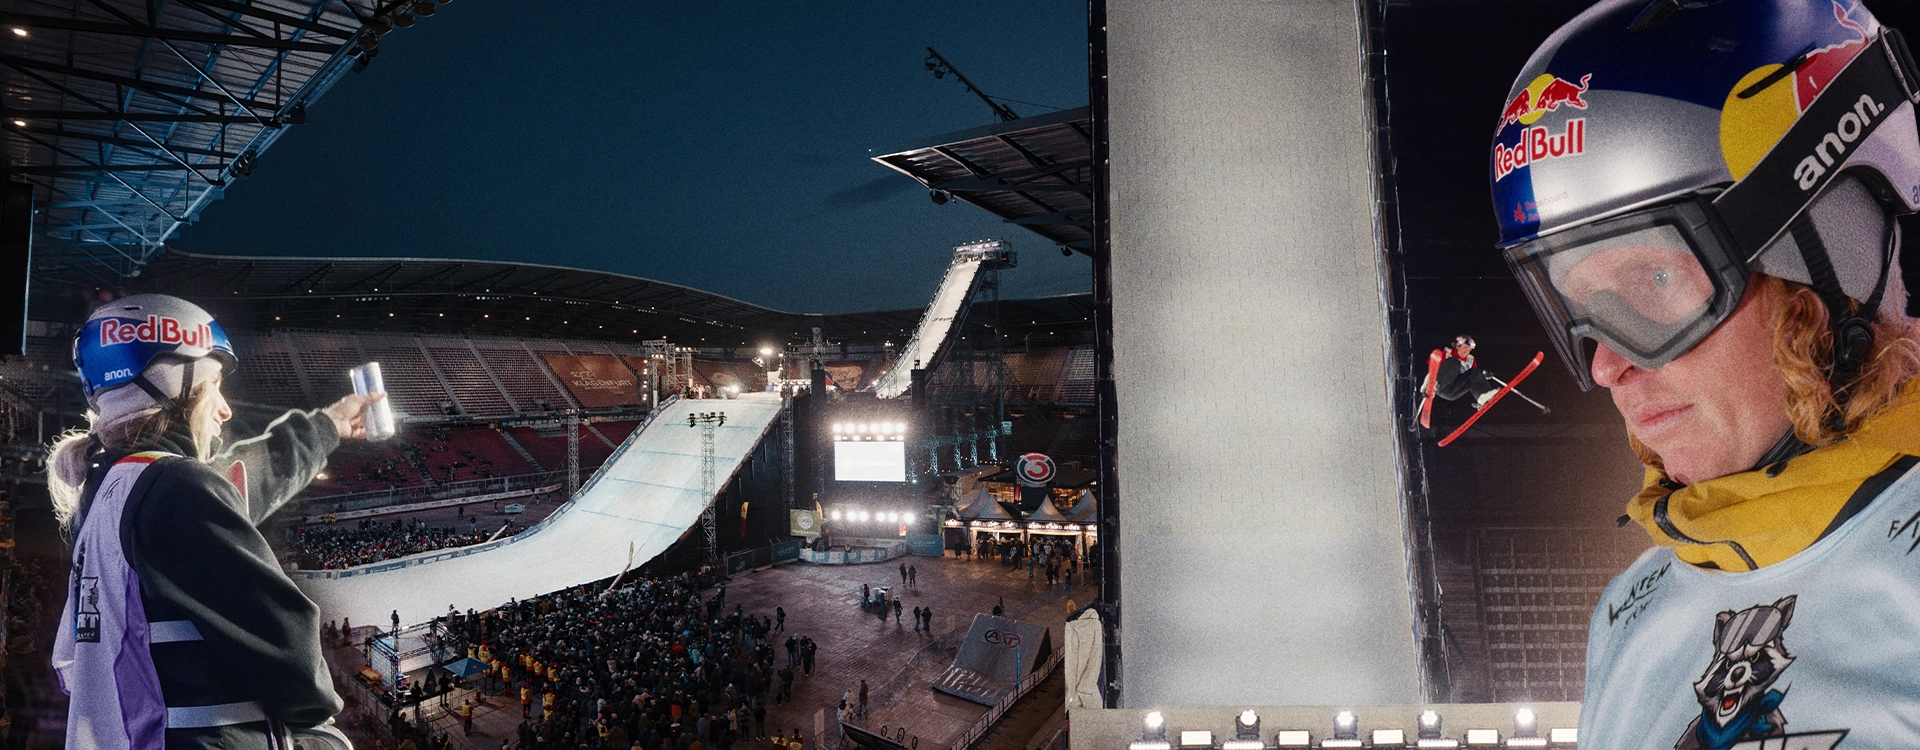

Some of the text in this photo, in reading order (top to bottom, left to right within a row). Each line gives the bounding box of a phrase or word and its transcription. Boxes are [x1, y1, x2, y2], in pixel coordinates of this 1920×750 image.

[1495, 118, 1586, 182] Red Bull
[1793, 94, 1885, 191] anon.
[101, 315, 212, 350] Red Bull
[104, 368, 133, 381] anon.
[573, 379, 632, 387] KLAGENFURT
